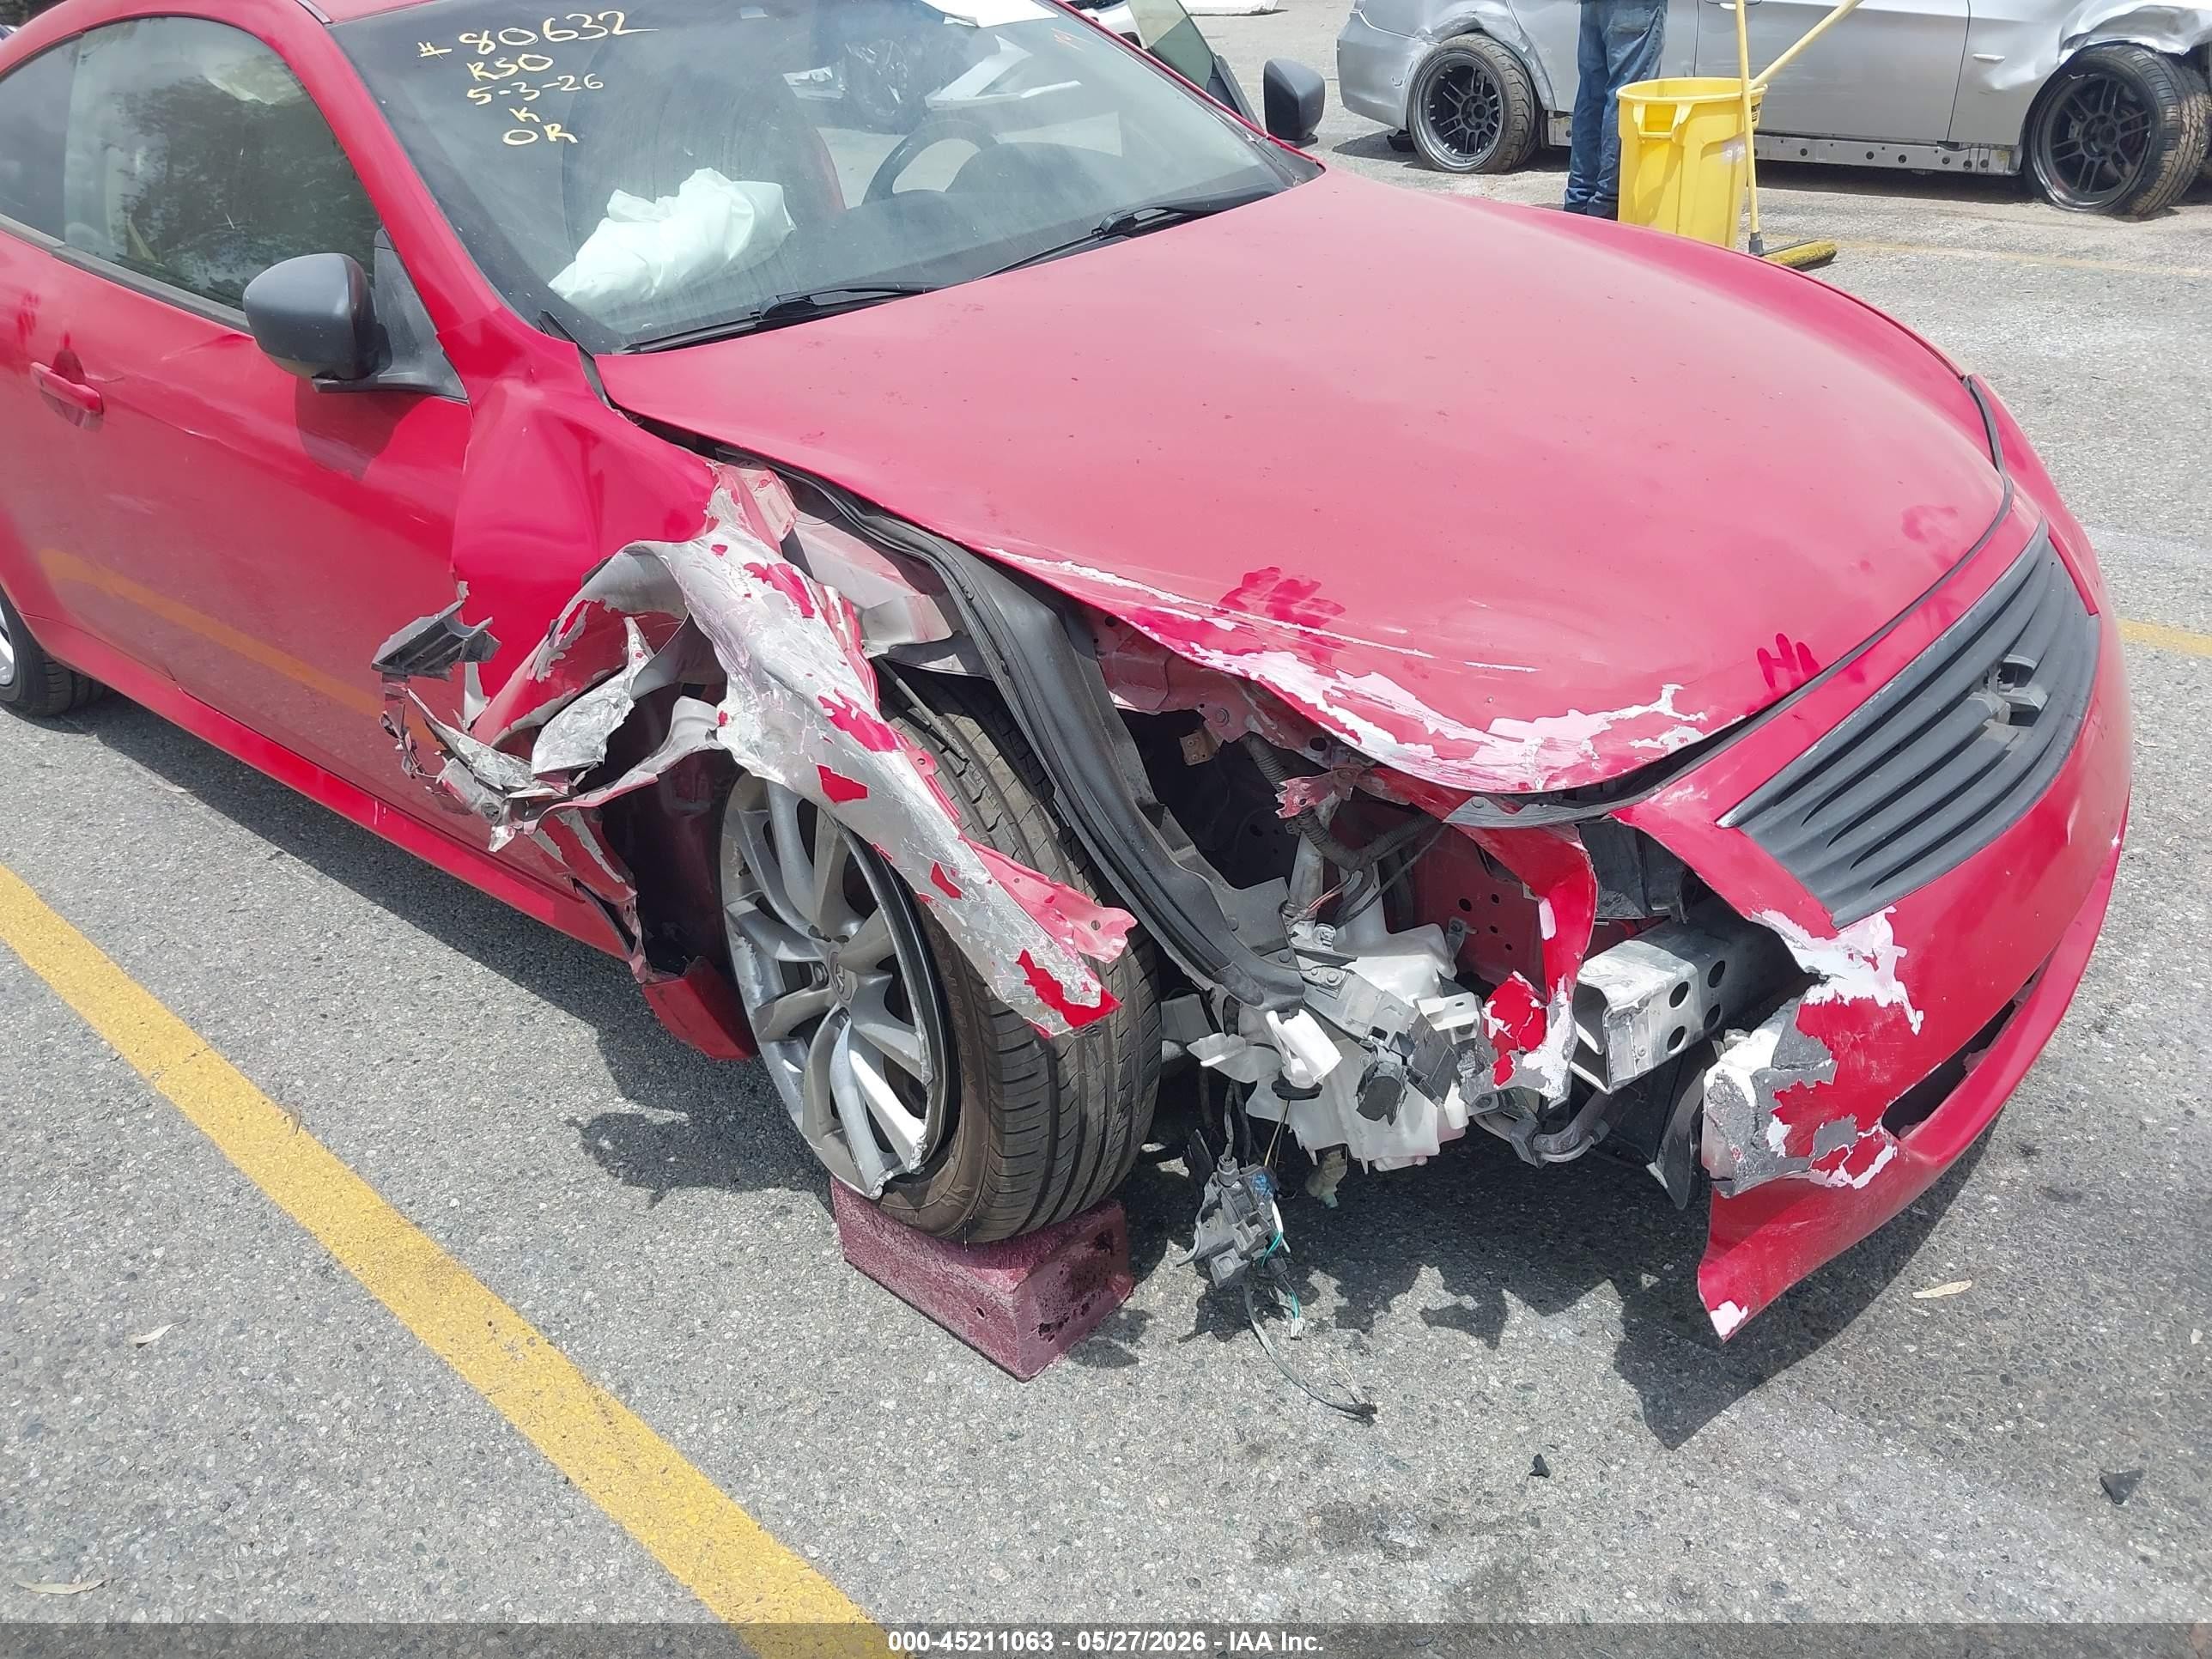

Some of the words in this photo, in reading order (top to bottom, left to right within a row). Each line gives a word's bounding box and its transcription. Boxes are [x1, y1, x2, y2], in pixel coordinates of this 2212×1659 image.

[459, 10, 660, 55] 80632
[466, 73, 604, 106] 5-3-26
[509, 106, 541, 123] K
